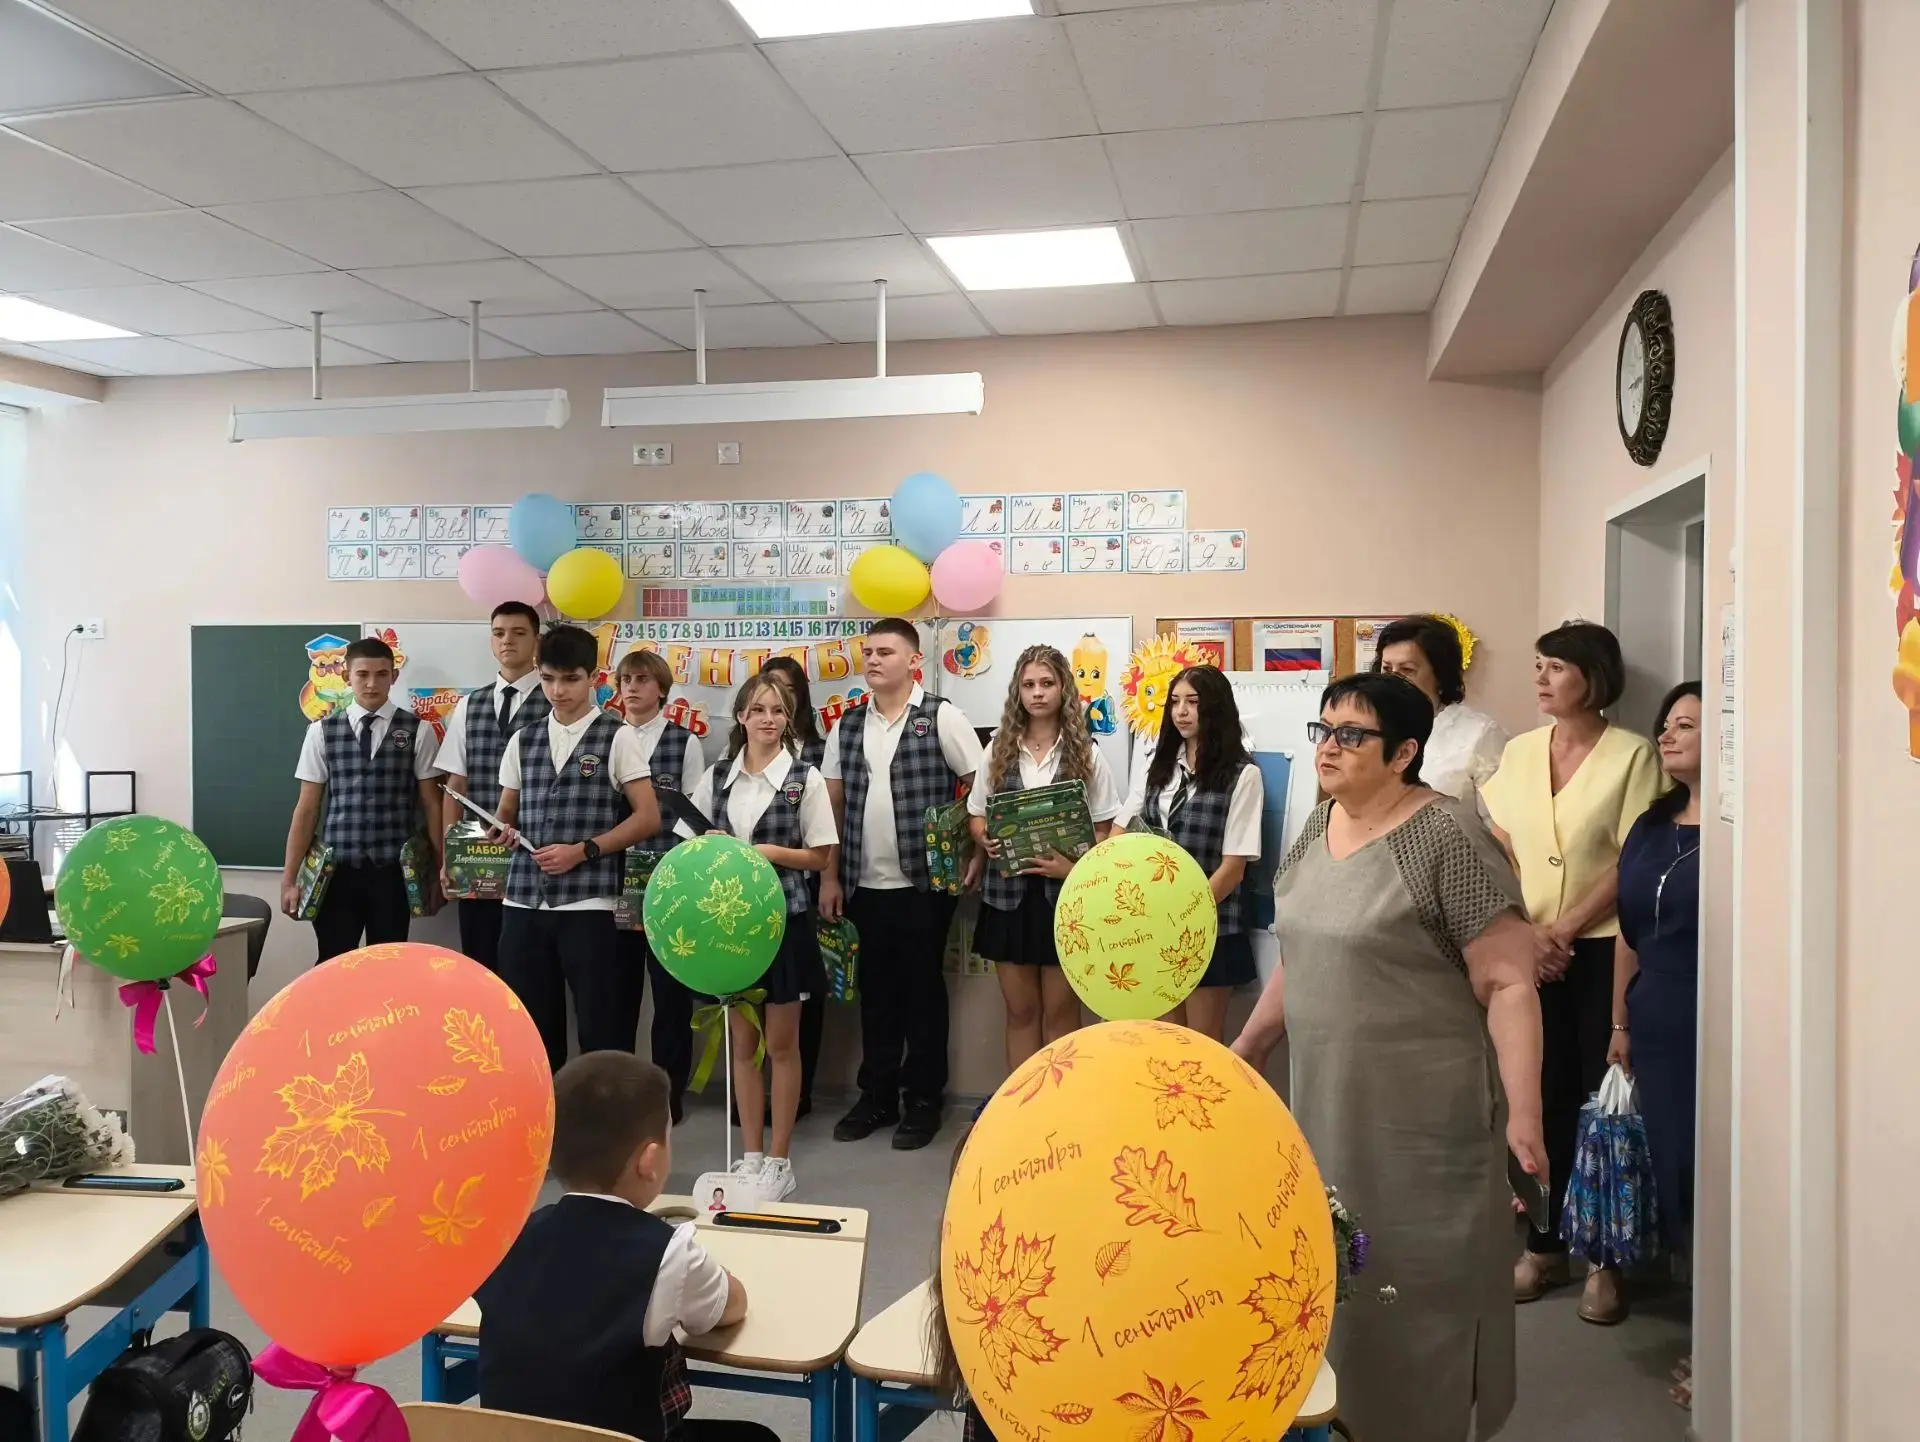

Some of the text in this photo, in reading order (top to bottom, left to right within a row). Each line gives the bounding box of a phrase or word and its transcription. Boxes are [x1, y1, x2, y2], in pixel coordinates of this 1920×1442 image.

[592, 623, 618, 670] 1
[625, 623, 634, 638] 3
[636, 622, 645, 639] 4
[648, 623, 656, 638] 5
[660, 623, 668, 638] 6
[671, 622, 680, 638] 7
[682, 622, 691, 638] 8
[694, 622, 703, 638] 9
[706, 622, 719, 638] 10
[725, 622, 736, 637] 11
[739, 621, 753, 637] 12
[756, 621, 770, 636] 13
[773, 621, 788, 637] 14
[790, 621, 803, 637] 15
[808, 621, 821, 636] 16
[825, 620, 839, 636] 17
[842, 620, 856, 636] 18
[1027, 816, 1055, 826] НАБОР
[467, 845, 506, 855] НАБОР
[299, 998, 420, 1058] 1 сентября
[410, 1097, 518, 1160] 1 сентября
[972, 1166, 984, 1205] 1
[993, 1131, 1084, 1194] сентября
[256, 1196, 353, 1275] 1 сентября
[1238, 1211, 1263, 1249] 1
[1081, 1278, 1225, 1358] 1 сентября
